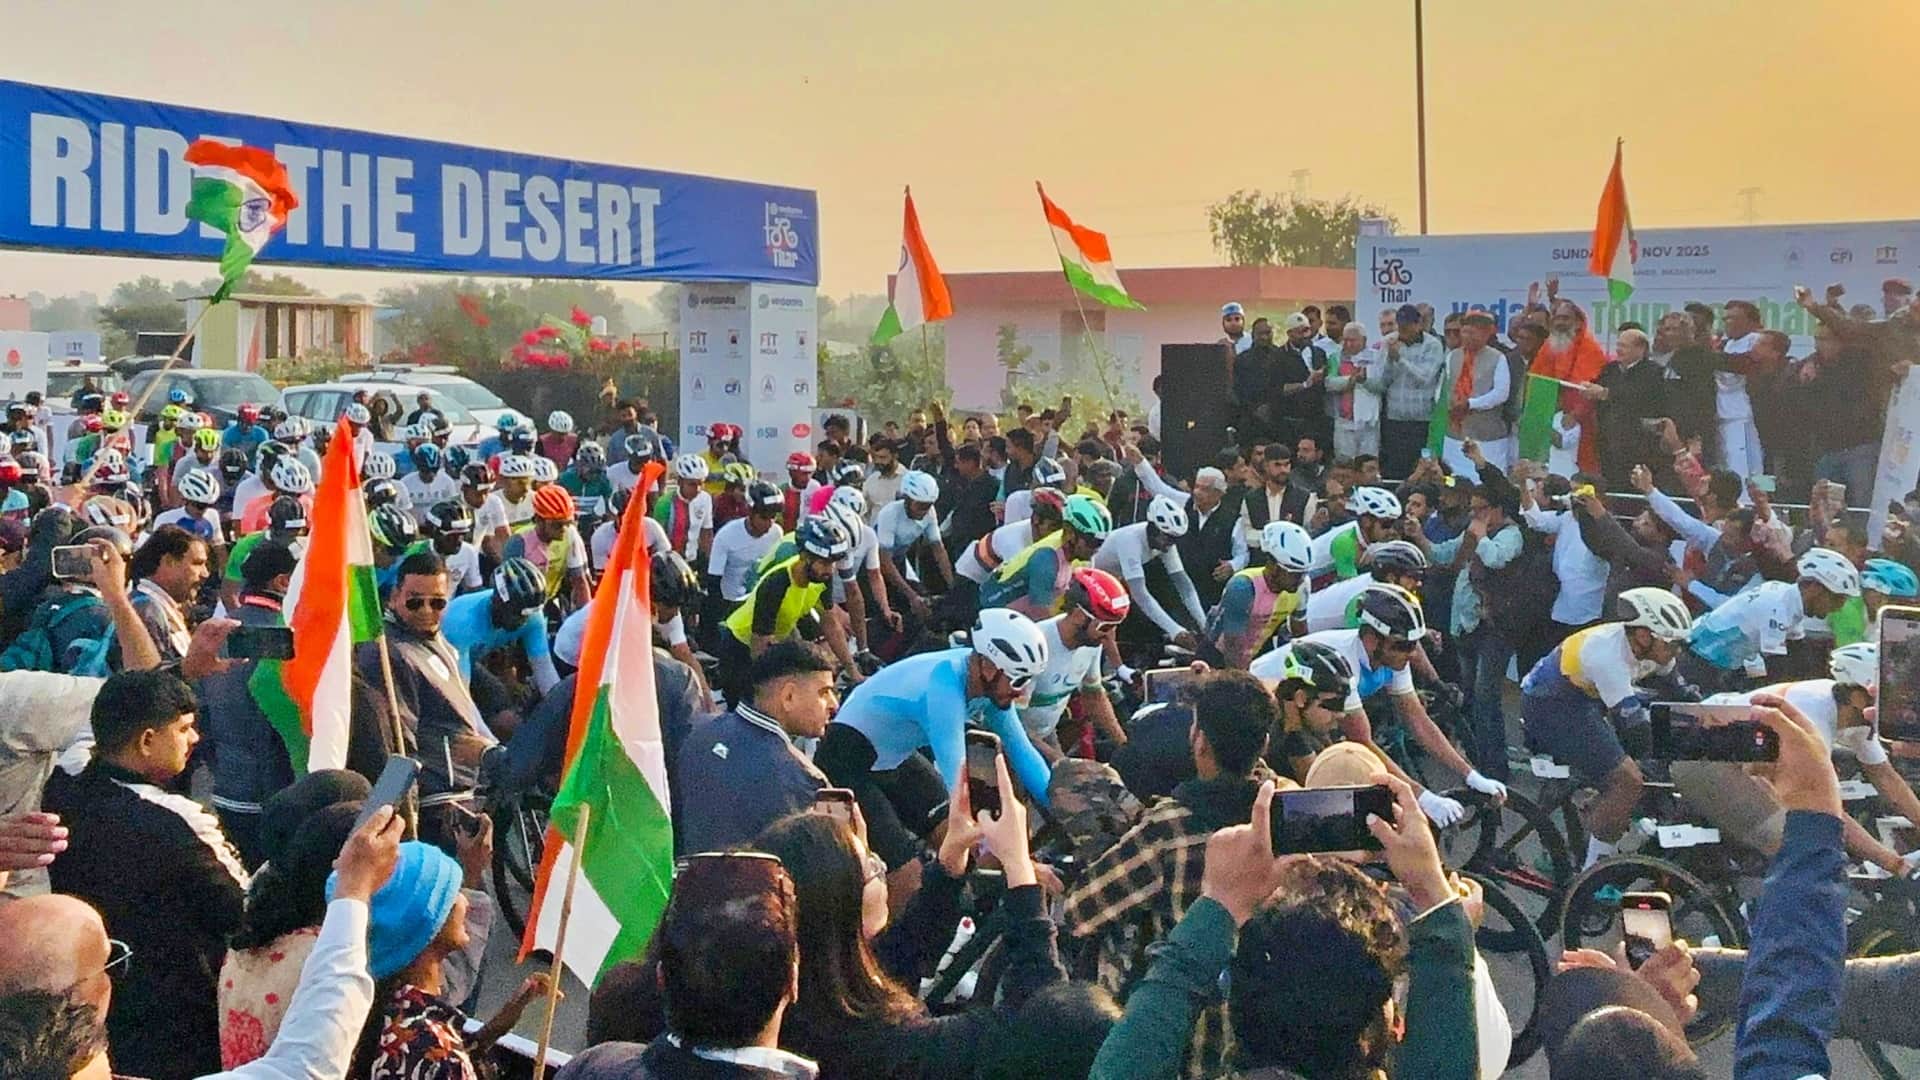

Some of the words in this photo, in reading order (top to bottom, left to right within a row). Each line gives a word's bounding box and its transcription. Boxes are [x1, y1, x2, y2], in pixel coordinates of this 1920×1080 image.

[30, 112, 242, 240] RID
[274, 143, 415, 252] THE
[441, 164, 661, 267] DESERT
[1642, 247, 1672, 258] NOV
[1676, 245, 1711, 257] 2025
[1380, 287, 1411, 303] Thar
